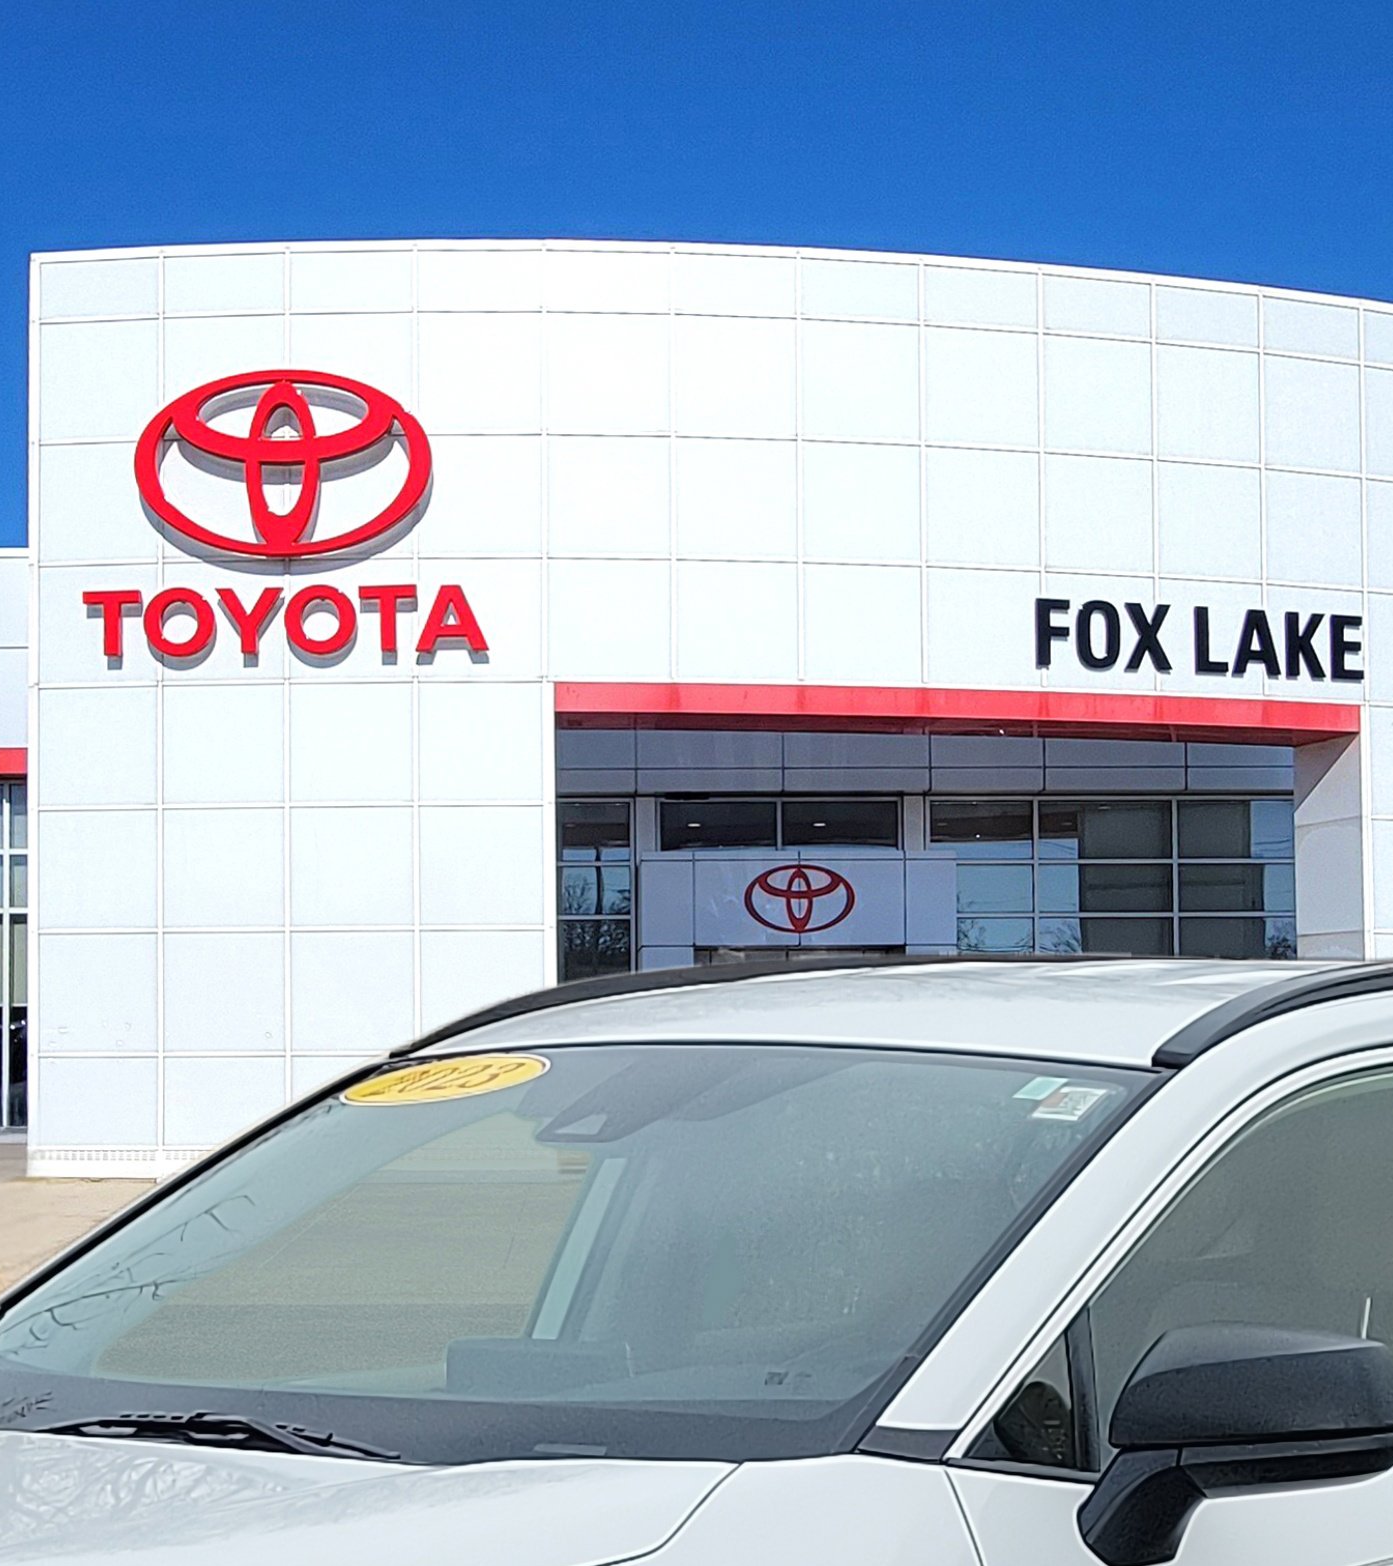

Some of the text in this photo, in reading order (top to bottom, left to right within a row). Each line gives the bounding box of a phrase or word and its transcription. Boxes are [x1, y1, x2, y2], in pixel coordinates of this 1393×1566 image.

[82, 584, 490, 660] TOYOTA
[1034, 597, 1365, 682] FOX LAKE
